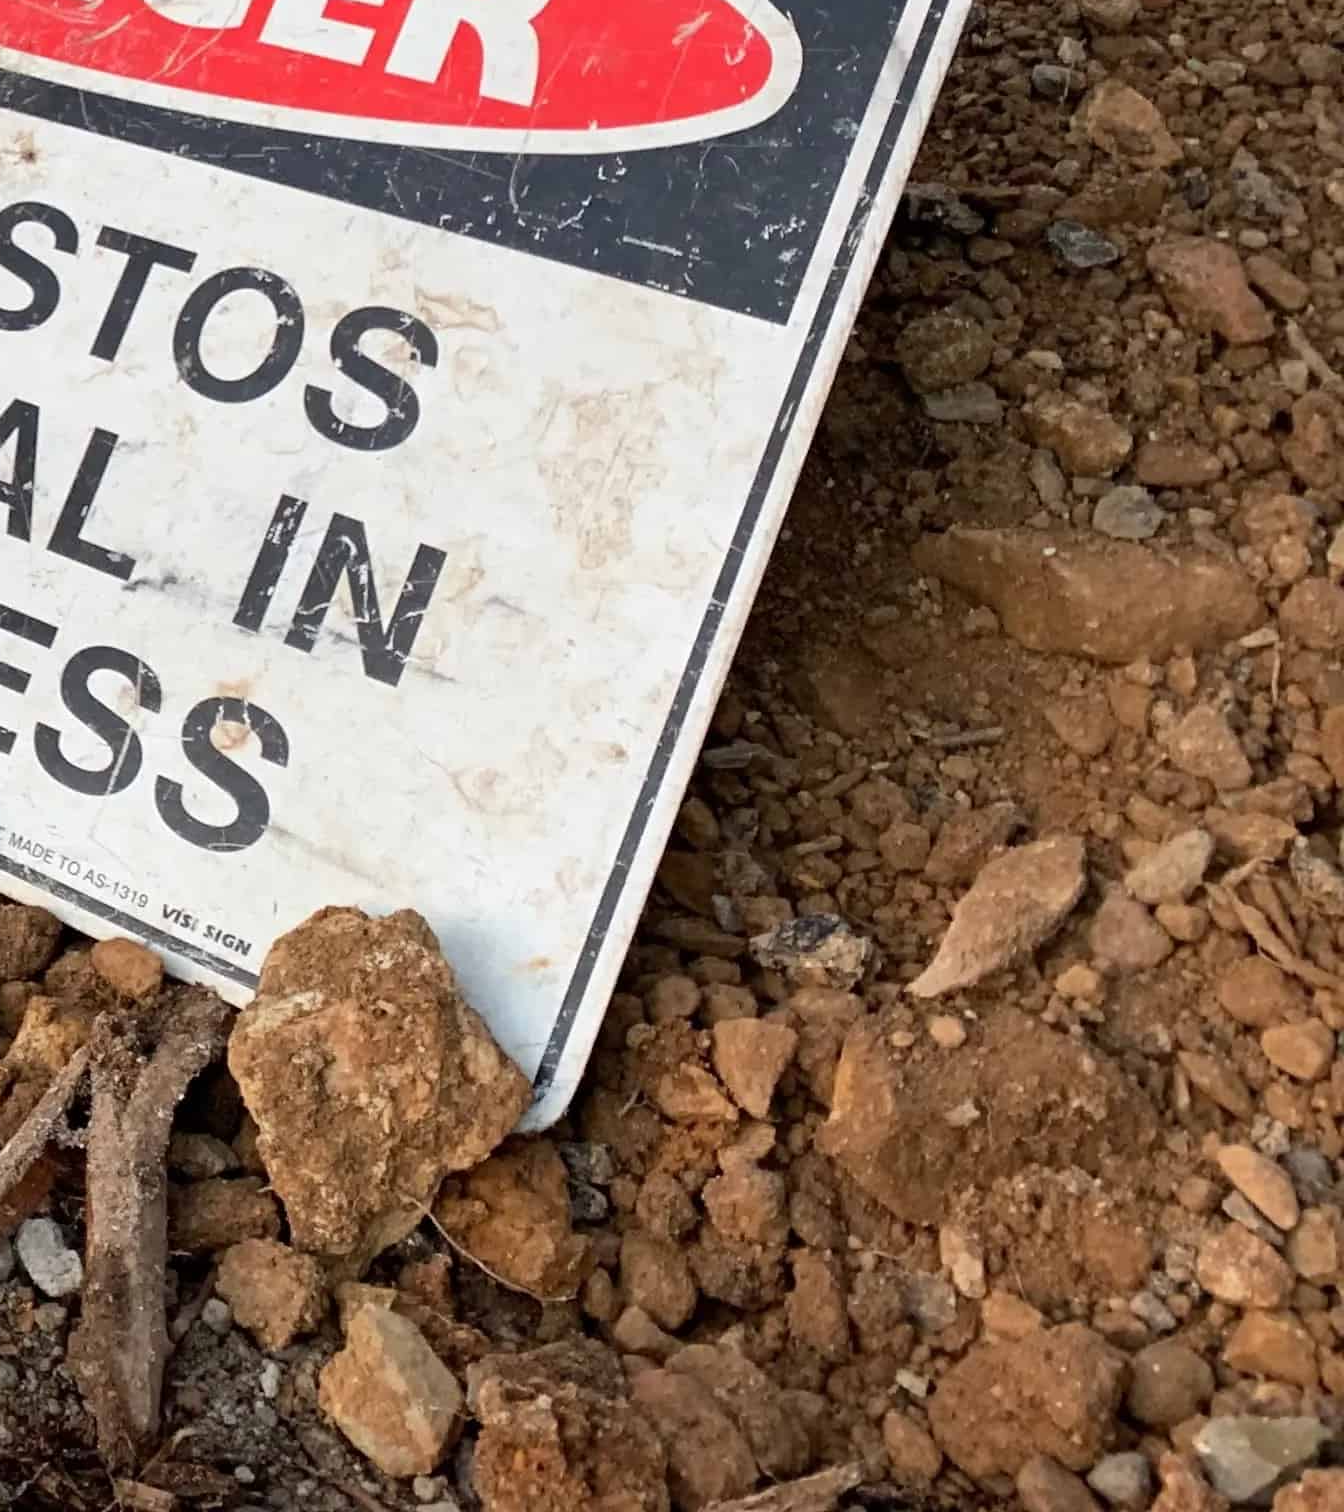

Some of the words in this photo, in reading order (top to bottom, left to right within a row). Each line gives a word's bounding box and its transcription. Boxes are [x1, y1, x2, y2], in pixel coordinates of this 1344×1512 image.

[232, 493, 448, 687] IN
[7, 832, 56, 864] MADE
[58, 854, 81, 876] TO
[83, 869, 149, 908] AS-1319
[203, 924, 252, 956] SIGN
